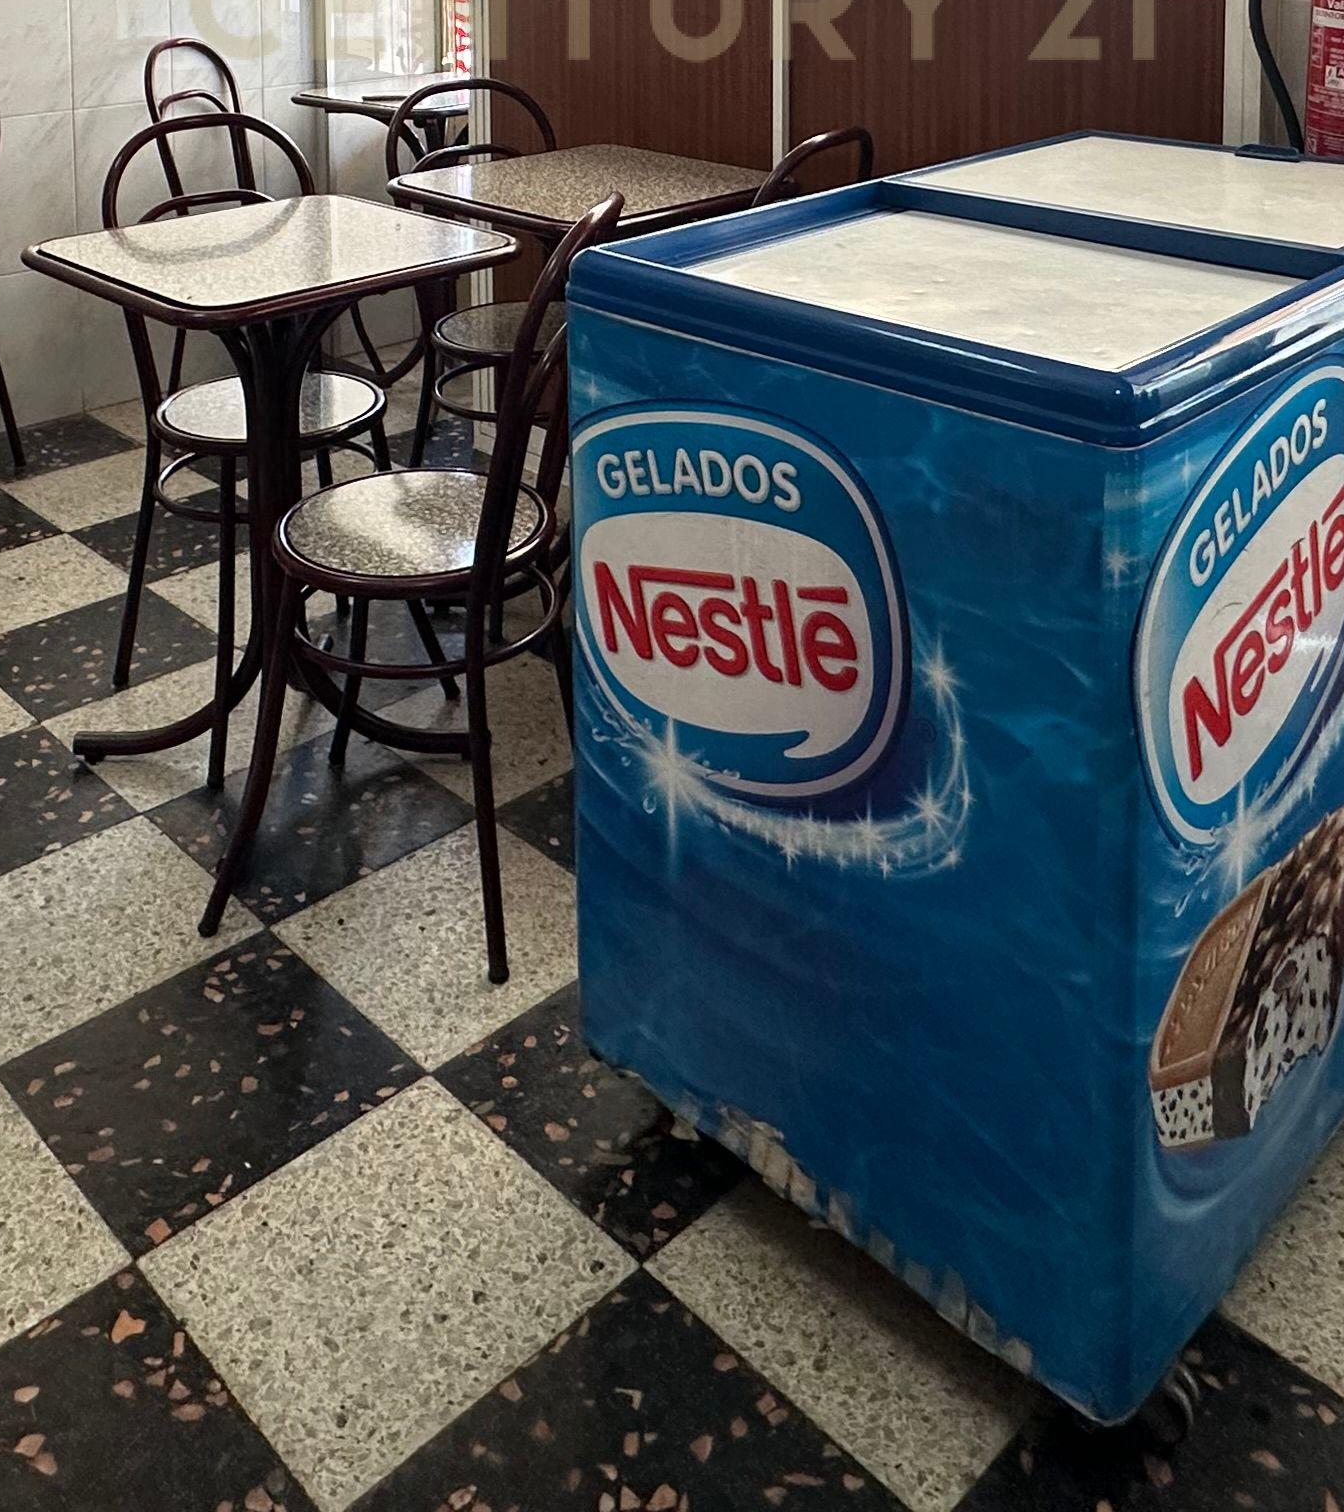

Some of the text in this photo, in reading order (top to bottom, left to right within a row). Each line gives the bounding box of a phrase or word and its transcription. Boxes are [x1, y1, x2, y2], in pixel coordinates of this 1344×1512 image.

[596, 447, 802, 513] GELADOS
[1188, 397, 1328, 588] GELADOS
[592, 560, 859, 693] Nestlé
